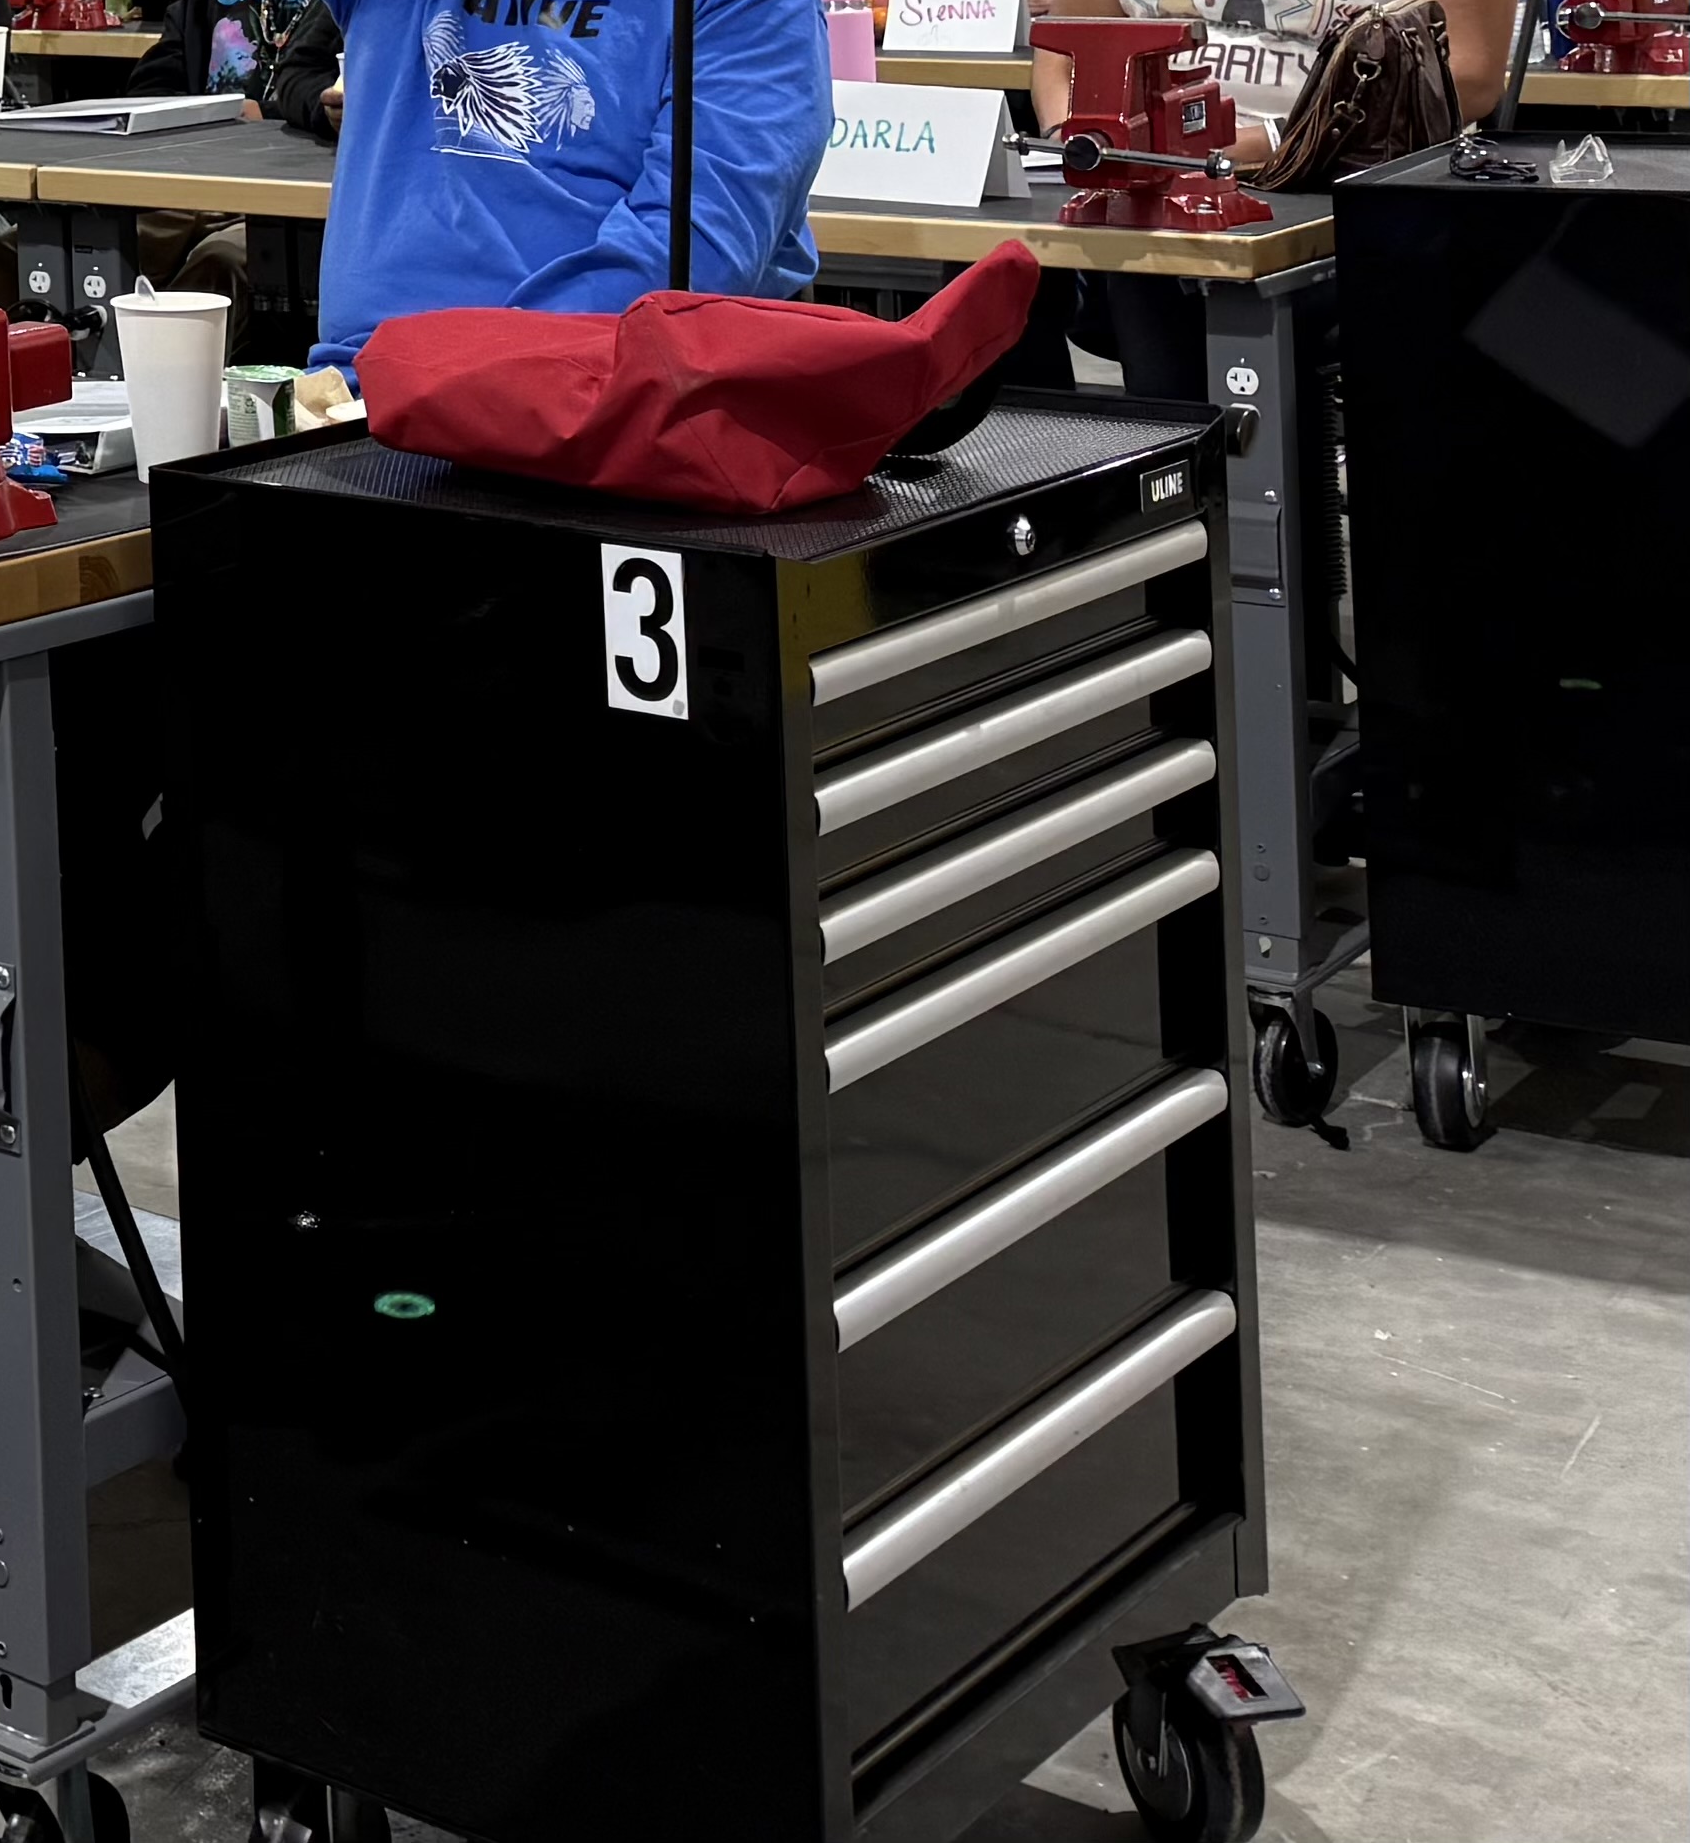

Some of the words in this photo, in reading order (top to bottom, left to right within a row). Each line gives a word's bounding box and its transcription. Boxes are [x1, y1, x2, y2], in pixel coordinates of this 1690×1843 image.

[829, 117, 936, 154] DARLA
[1151, 471, 1184, 502] ULINE
[612, 557, 679, 702] 3
